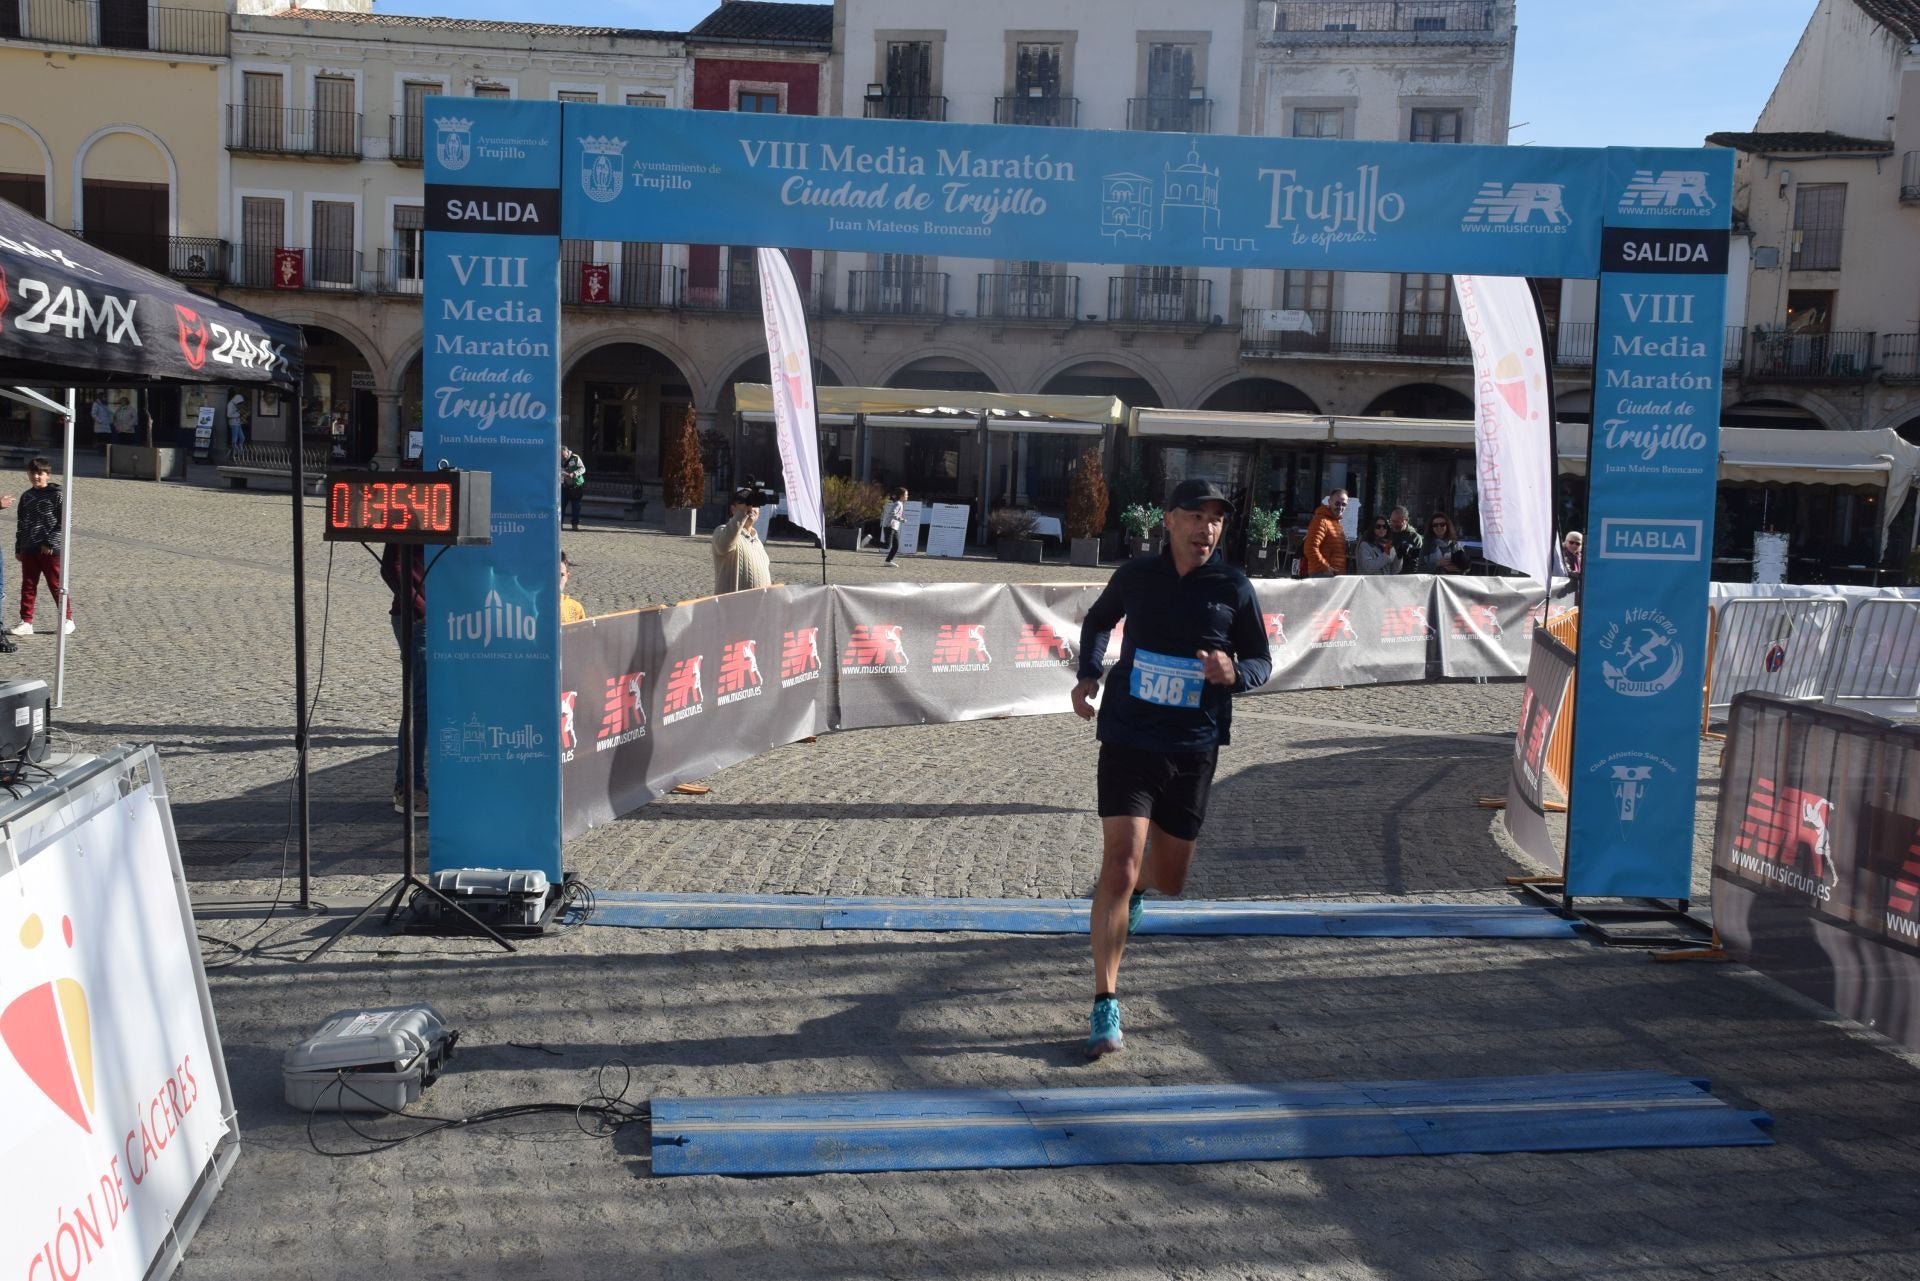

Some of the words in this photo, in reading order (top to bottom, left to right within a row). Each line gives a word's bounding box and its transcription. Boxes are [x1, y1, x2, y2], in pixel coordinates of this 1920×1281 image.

[476, 146, 526, 161] Trujillo
[477, 135, 537, 149] Ayuntamiento
[538, 137, 549, 146] de
[632, 159, 707, 175] Ayuntamiento
[708, 163, 722, 174] de
[738, 139, 809, 169] VIII
[820, 144, 926, 176] Media
[936, 149, 1076, 182] Maratón
[631, 173, 692, 193] Trujillo
[780, 175, 889, 209] Ciudad
[894, 183, 932, 211] de
[942, 182, 1048, 225] Trujillo
[1258, 164, 1405, 235] Trujillo
[446, 199, 539, 224] SALIDA
[1617, 205, 1712, 218] www.musicrun.es
[827, 217, 863, 233] Juan
[866, 218, 919, 235] Mateos
[923, 221, 992, 237] Broncano
[1460, 222, 1567, 236] www.musicrun.es
[1622, 240, 1709, 263] SALIDA
[447, 254, 529, 288] VIII
[14, 277, 143, 347] 24MX
[441, 299, 543, 323] Media
[1619, 293, 1696, 324] VIII
[210, 322, 295, 381] 24MX
[434, 334, 550, 357] Maratón
[1612, 335, 1708, 358] Media
[449, 365, 510, 383] Ciudad
[511, 369, 535, 384] de
[1605, 369, 1713, 390] Maratón
[434, 386, 547, 431] Trujillo
[1616, 399, 1671, 415] Ciudad
[1674, 401, 1696, 416] de
[439, 433, 461, 445] Juan
[463, 434, 497, 445] Mateos
[499, 435, 545, 445] Broncano
[1602, 419, 1708, 461] Trujillo
[1605, 463, 1626, 474] Juan
[1628, 464, 1660, 474] Mateos
[1661, 465, 1704, 475] Broncano
[489, 511, 538, 520] untamiento
[538, 511, 549, 520] de
[490, 522, 525, 535] ujillo
[1614, 530, 1687, 549] HABLA
[1598, 621, 1619, 649] Club
[1625, 607, 1678, 635] Atletismo
[781, 669, 820, 689] www.musicrun.es
[841, 662, 908, 676] www.musicrun.es
[931, 662, 990, 674] www.musicrun.es
[717, 685, 762, 707] www.musicrun.es
[1139, 670, 1186, 706] 548
[663, 703, 703, 726] www.musicrun.es
[487, 724, 543, 750] Trujillo
[596, 727, 646, 753] www.musicrun.es
[1731, 848, 1832, 902] www.musicrun.es
[100, 1153, 129, 1232] DE
[125, 1054, 198, 1186] CÁCERES
